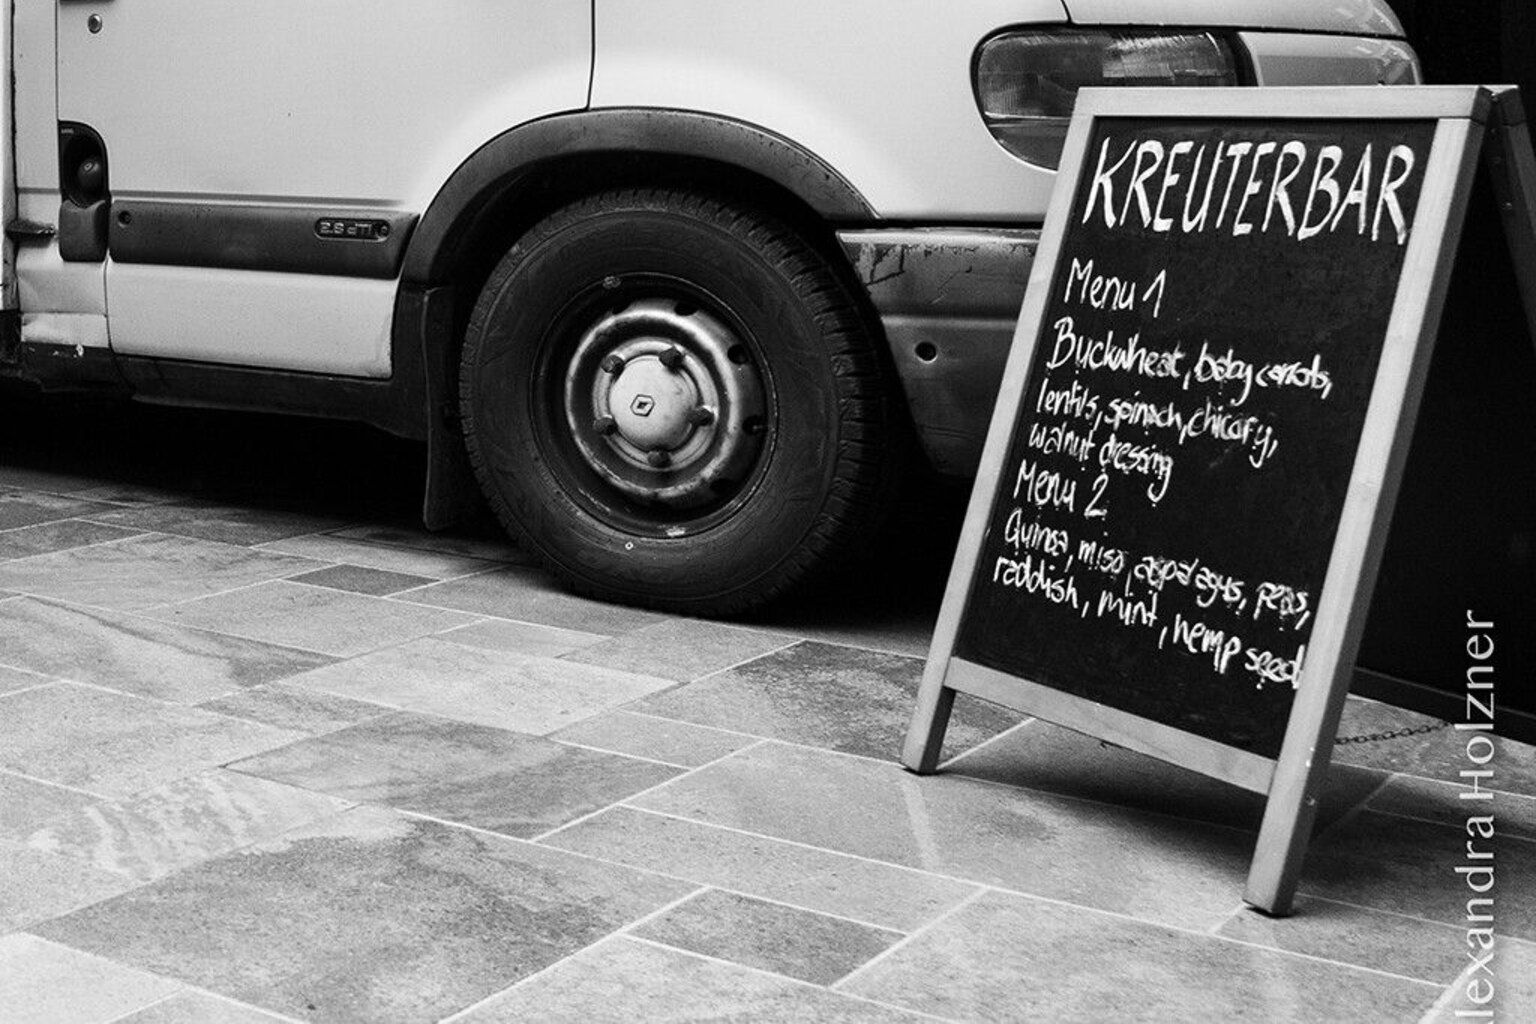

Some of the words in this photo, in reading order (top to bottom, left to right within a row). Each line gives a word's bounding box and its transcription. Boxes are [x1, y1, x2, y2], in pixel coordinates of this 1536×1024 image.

[1082, 136, 1415, 246] KREUTERBAR
[1064, 257, 1136, 312] Menu
[1143, 268, 1166, 319] 1
[1193, 339, 1254, 407] baby
[1013, 459, 1077, 513] Menu
[1083, 473, 1110, 518] 2
[1028, 421, 1097, 463] walnut
[1098, 431, 1175, 503] dressing
[1172, 612, 1242, 675] hemp
